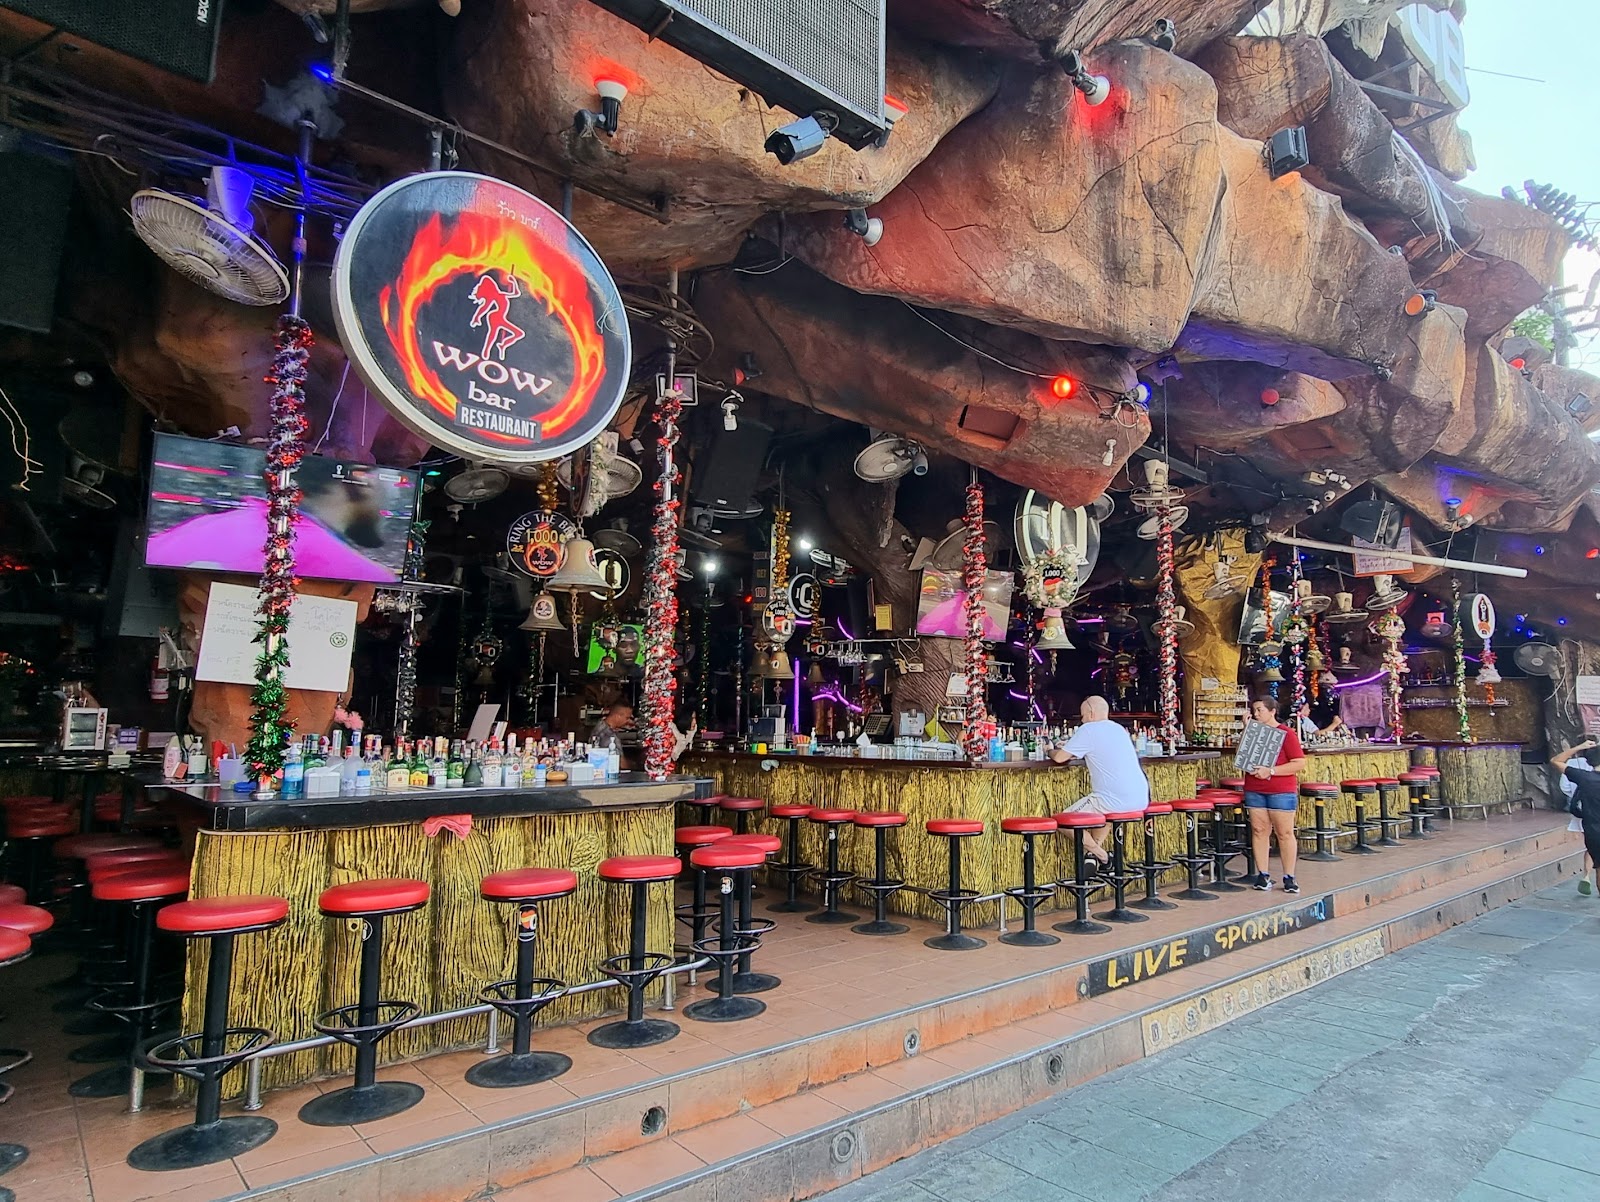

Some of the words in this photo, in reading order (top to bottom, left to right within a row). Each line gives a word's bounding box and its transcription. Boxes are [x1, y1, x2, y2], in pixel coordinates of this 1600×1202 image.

[432, 340, 553, 396] WOW
[467, 380, 516, 411] bar
[460, 406, 537, 439] RESTAURANT
[510, 517, 532, 543] RING
[533, 513, 557, 526] THE
[1106, 938, 1188, 988] LIVE
[1215, 911, 1294, 949] SPORTS
